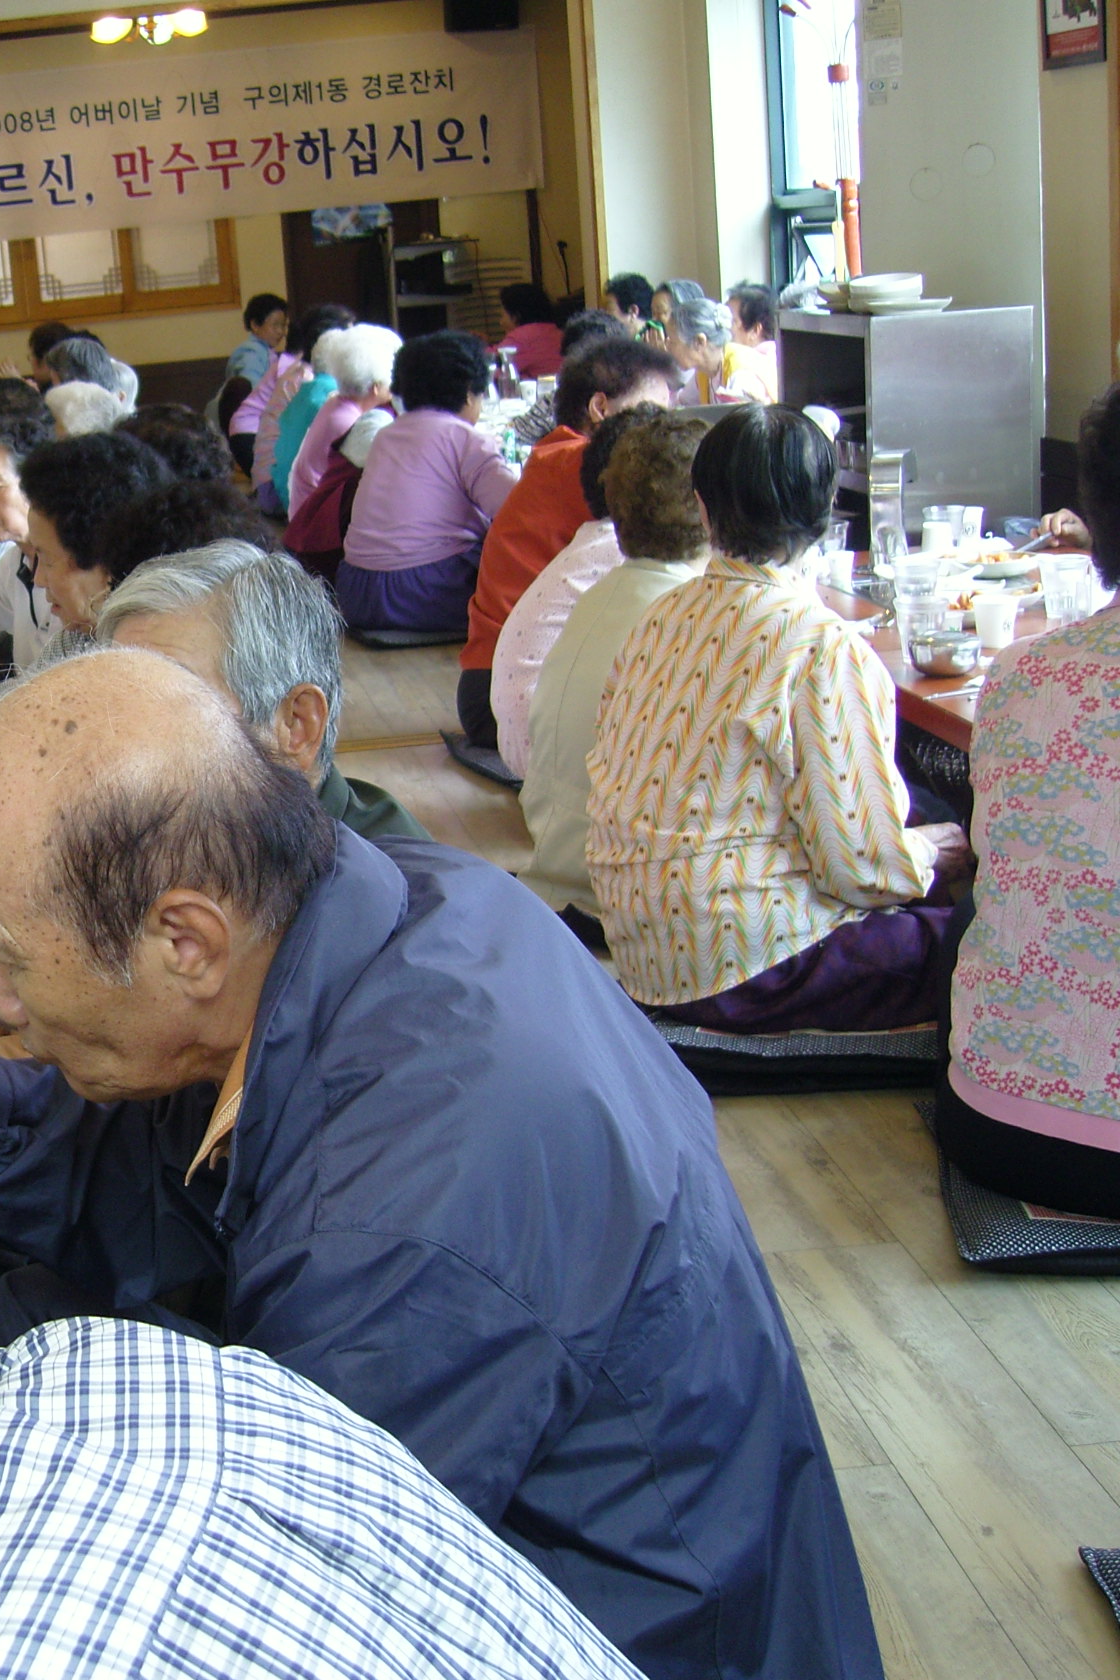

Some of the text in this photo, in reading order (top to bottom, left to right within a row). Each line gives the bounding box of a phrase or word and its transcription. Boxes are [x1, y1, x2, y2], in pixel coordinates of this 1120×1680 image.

[69, 95, 162, 128] 어버이날
[176, 89, 220, 117] 기념
[243, 77, 349, 110] 구의제1동
[362, 66, 455, 100] 경로잔치
[111, 113, 491, 199] 만수무강하십시오!
